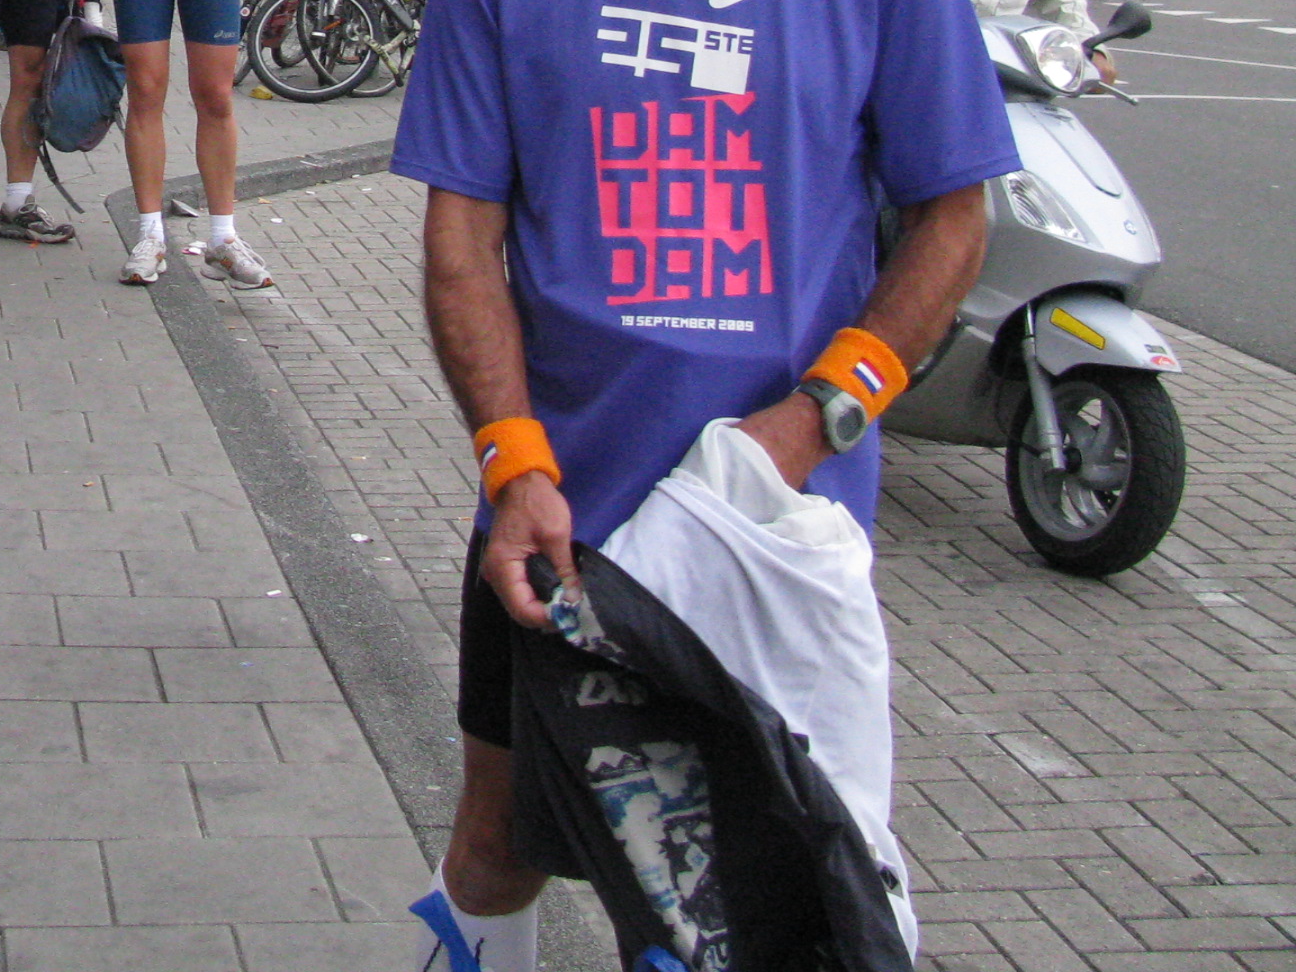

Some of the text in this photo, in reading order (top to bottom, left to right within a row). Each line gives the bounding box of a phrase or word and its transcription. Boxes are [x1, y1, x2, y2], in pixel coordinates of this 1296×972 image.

[704, 29, 754, 55] STE
[597, 96, 754, 163] DAM
[600, 167, 766, 232] TOT
[604, 235, 764, 298] DAM
[621, 315, 754, 332] 19 SEPTEMBER 2009
